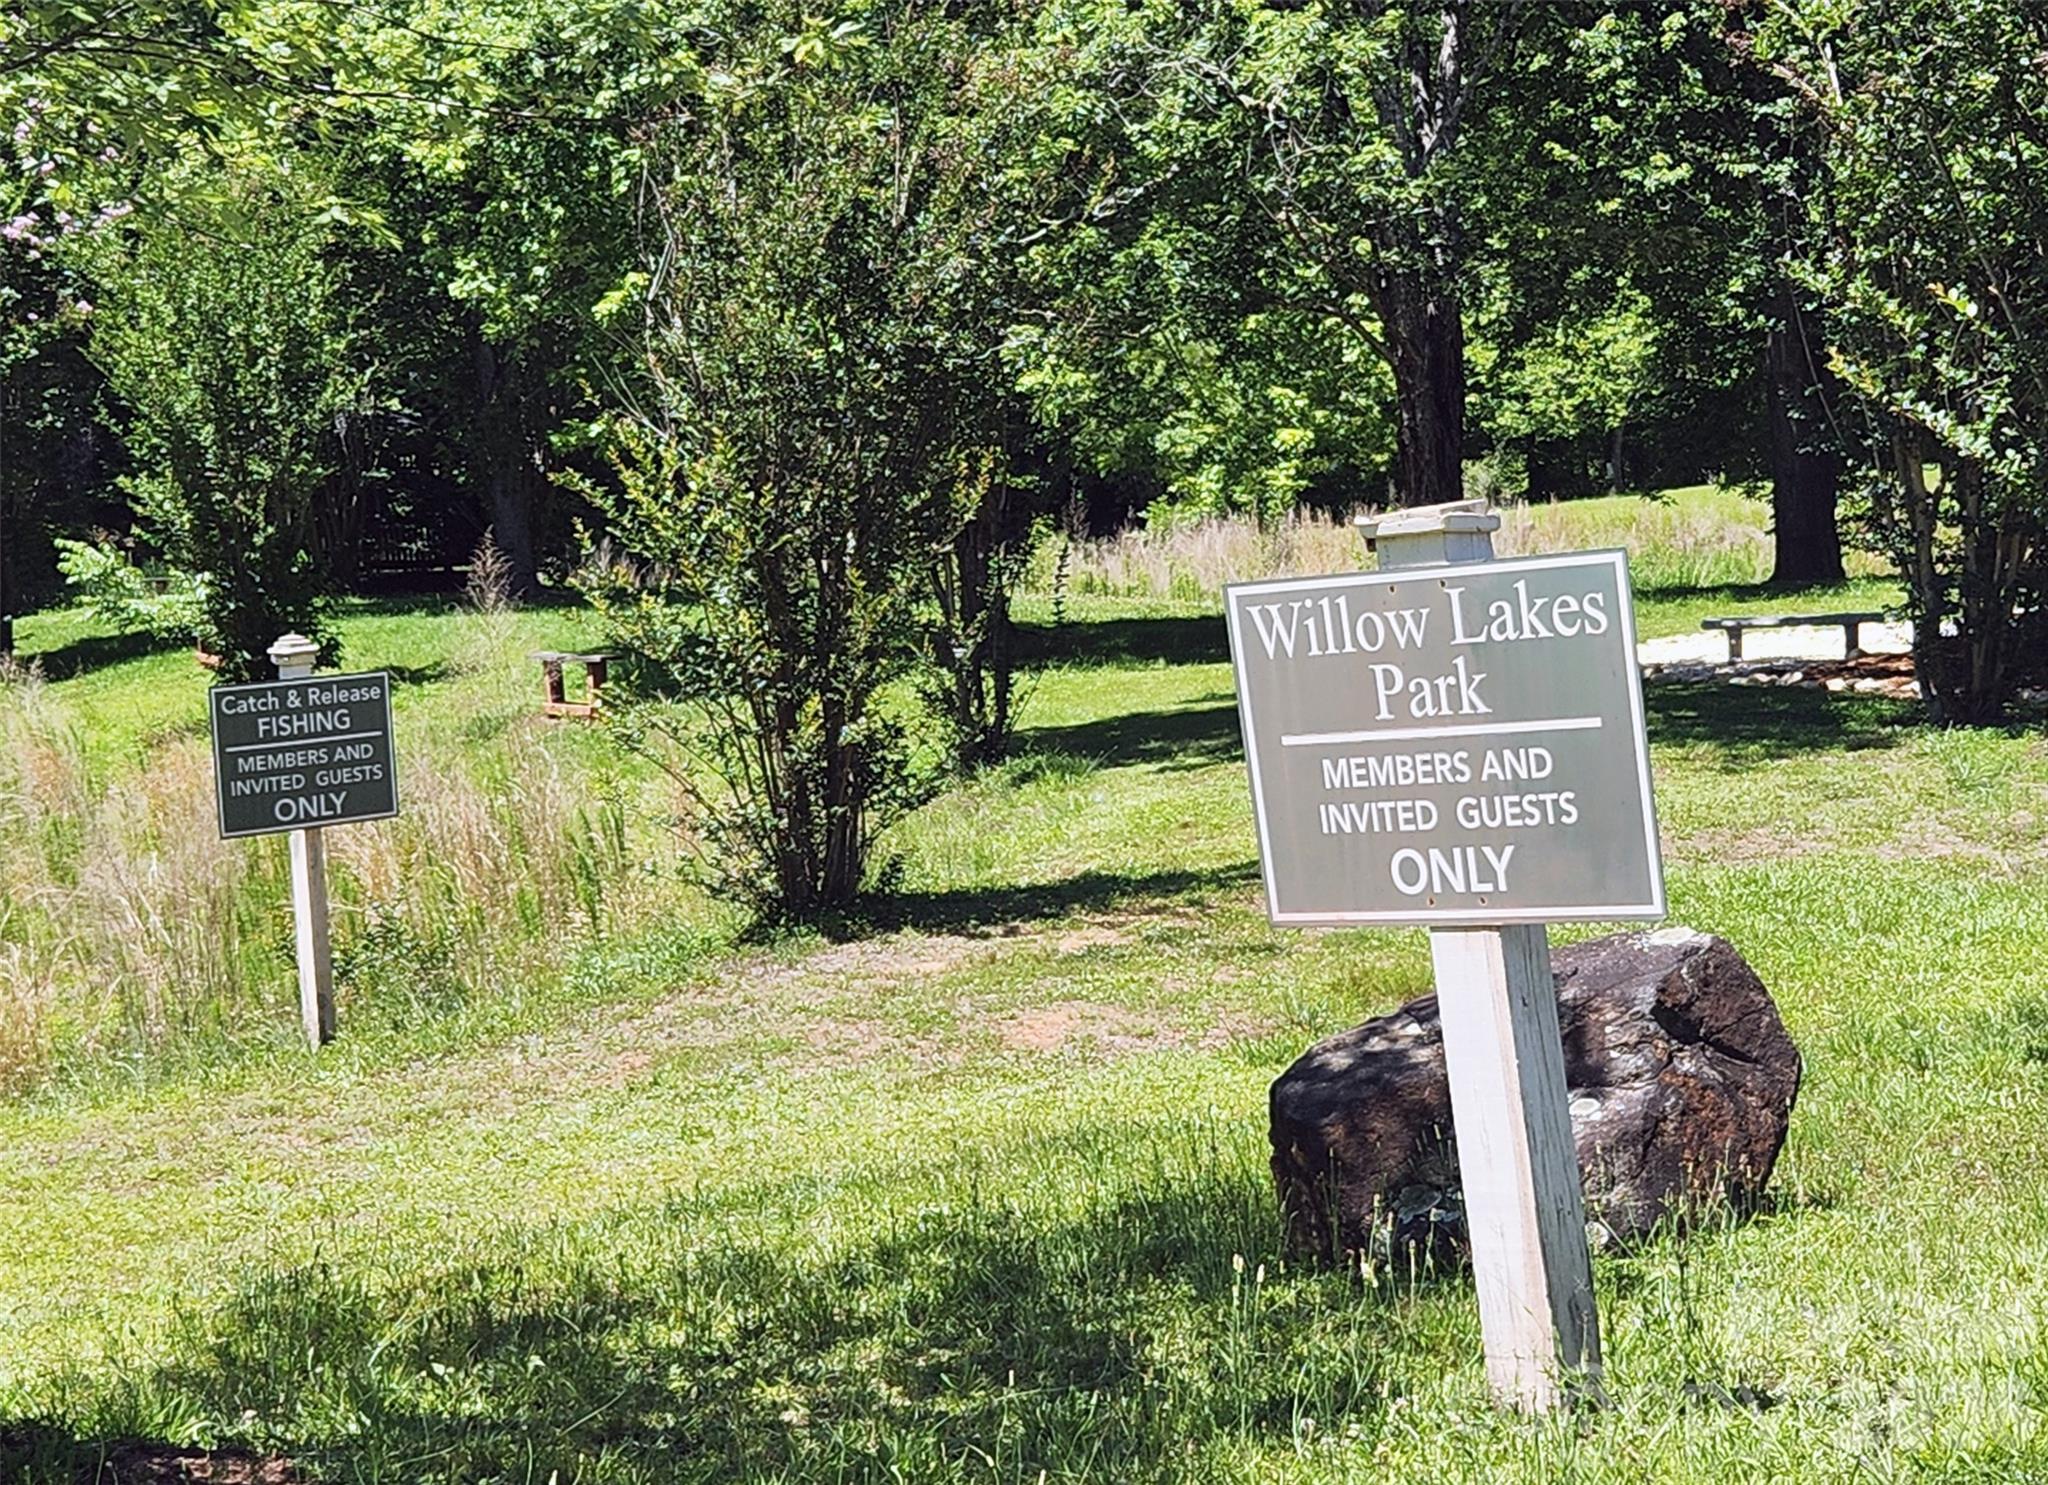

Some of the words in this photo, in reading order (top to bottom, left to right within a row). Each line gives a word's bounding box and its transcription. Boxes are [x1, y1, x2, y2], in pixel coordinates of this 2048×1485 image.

[1245, 594, 1431, 660] Willow
[1443, 579, 1609, 646] Lakes
[220, 691, 280, 715] Catch
[286, 689, 303, 708] &
[308, 684, 382, 706] Release
[1368, 654, 1493, 722] Park
[257, 708, 351, 739] FISHING
[237, 748, 329, 773] MEMBERS
[333, 743, 374, 762] AND
[1320, 750, 1473, 790] MEMBERS
[1480, 746, 1553, 782] AND
[230, 774, 305, 797] INVITED
[315, 764, 384, 787] GUESTS
[274, 791, 347, 822] ONLY
[1319, 799, 1438, 835] INVITED
[1456, 792, 1579, 829] GUESTS
[1389, 844, 1516, 896] ONLY
